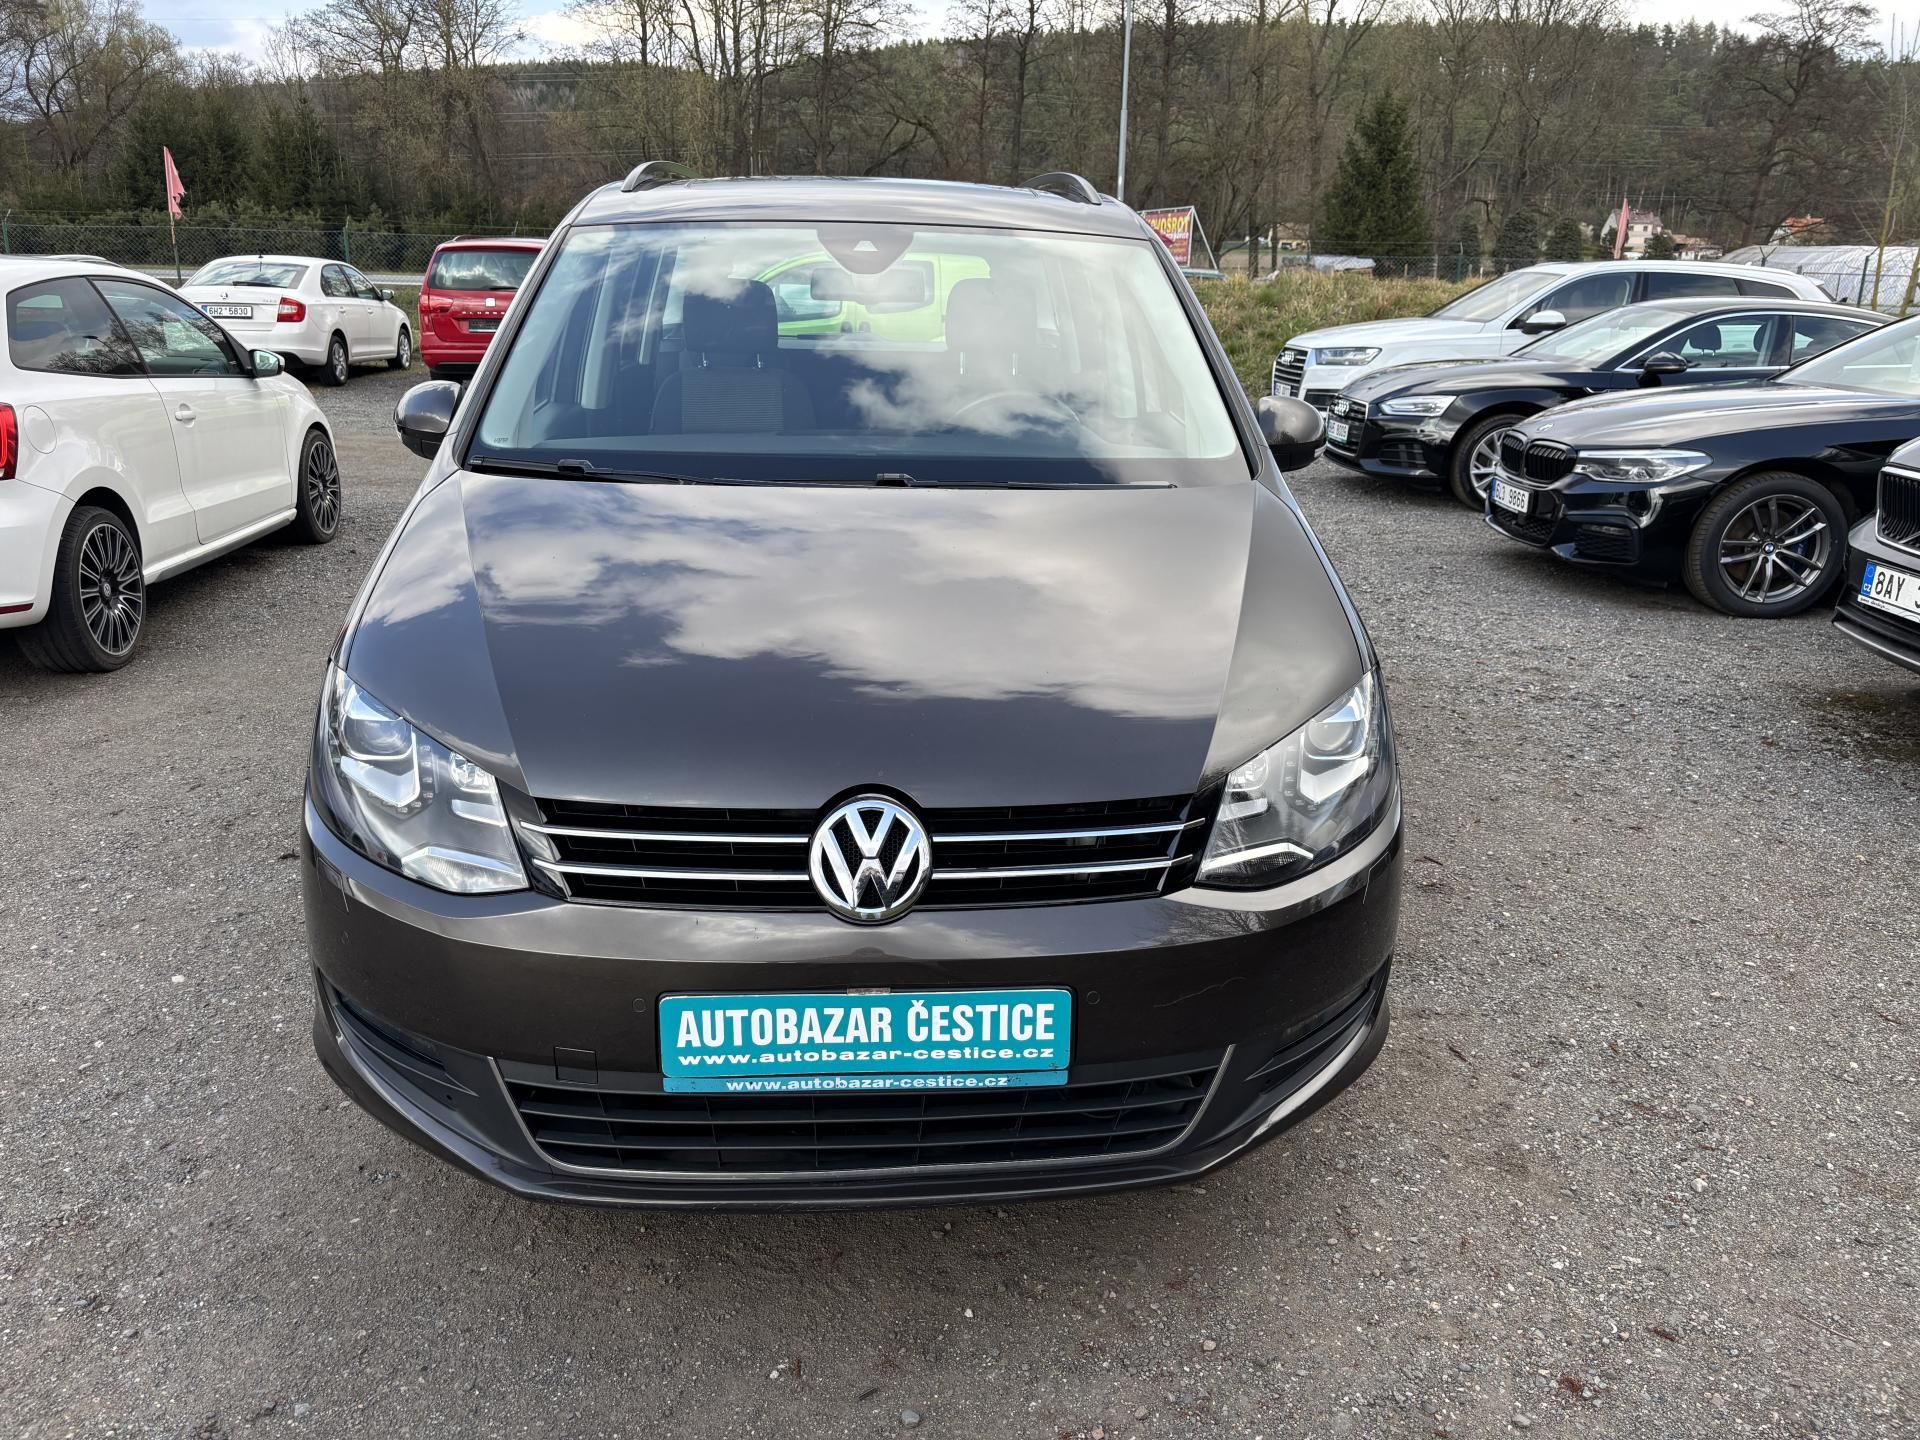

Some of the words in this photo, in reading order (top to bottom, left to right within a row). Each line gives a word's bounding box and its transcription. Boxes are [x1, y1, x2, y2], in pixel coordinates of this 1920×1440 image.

[208, 307, 223, 316] 6H2
[228, 307, 248, 316] 5830
[1863, 583, 1872, 592] CZ
[1875, 571, 1906, 602] 8AY
[676, 1006, 892, 1048] AUTOBAZAR
[907, 999, 1055, 1042] ČESTICE
[677, 1046, 1054, 1065] www.autobazar-cestice.cz
[726, 1075, 1008, 1091] www.autobazar-cestice.cz
